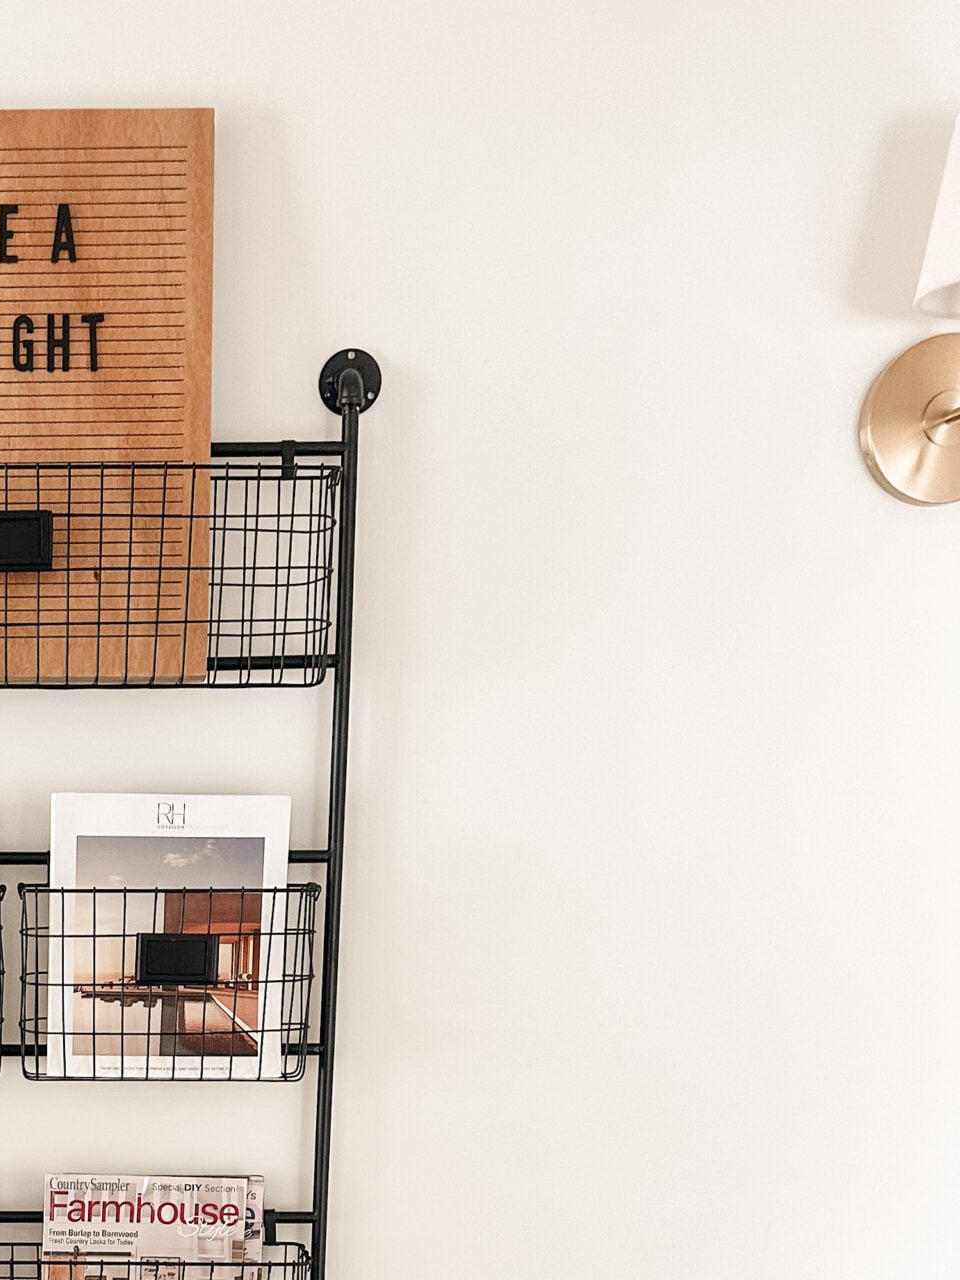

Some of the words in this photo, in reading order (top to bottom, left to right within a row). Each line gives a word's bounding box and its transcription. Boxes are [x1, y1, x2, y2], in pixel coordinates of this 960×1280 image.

[51, 203, 76, 263] A
[157, 802, 186, 825] RH
[152, 1182, 181, 1192] Special
[184, 1183, 202, 1192] DIY
[204, 1184, 239, 1193] Section!
[48, 1190, 239, 1226] Farmhouse
[48, 1228, 67, 1236] From
[68, 1228, 92, 1239] Burlap
[93, 1229, 100, 1237] to
[101, 1229, 139, 1238] Barnwood
[176, 1216, 237, 1241] Style
[65, 1238, 88, 1246] Country
[116, 1238, 134, 1247] Today
